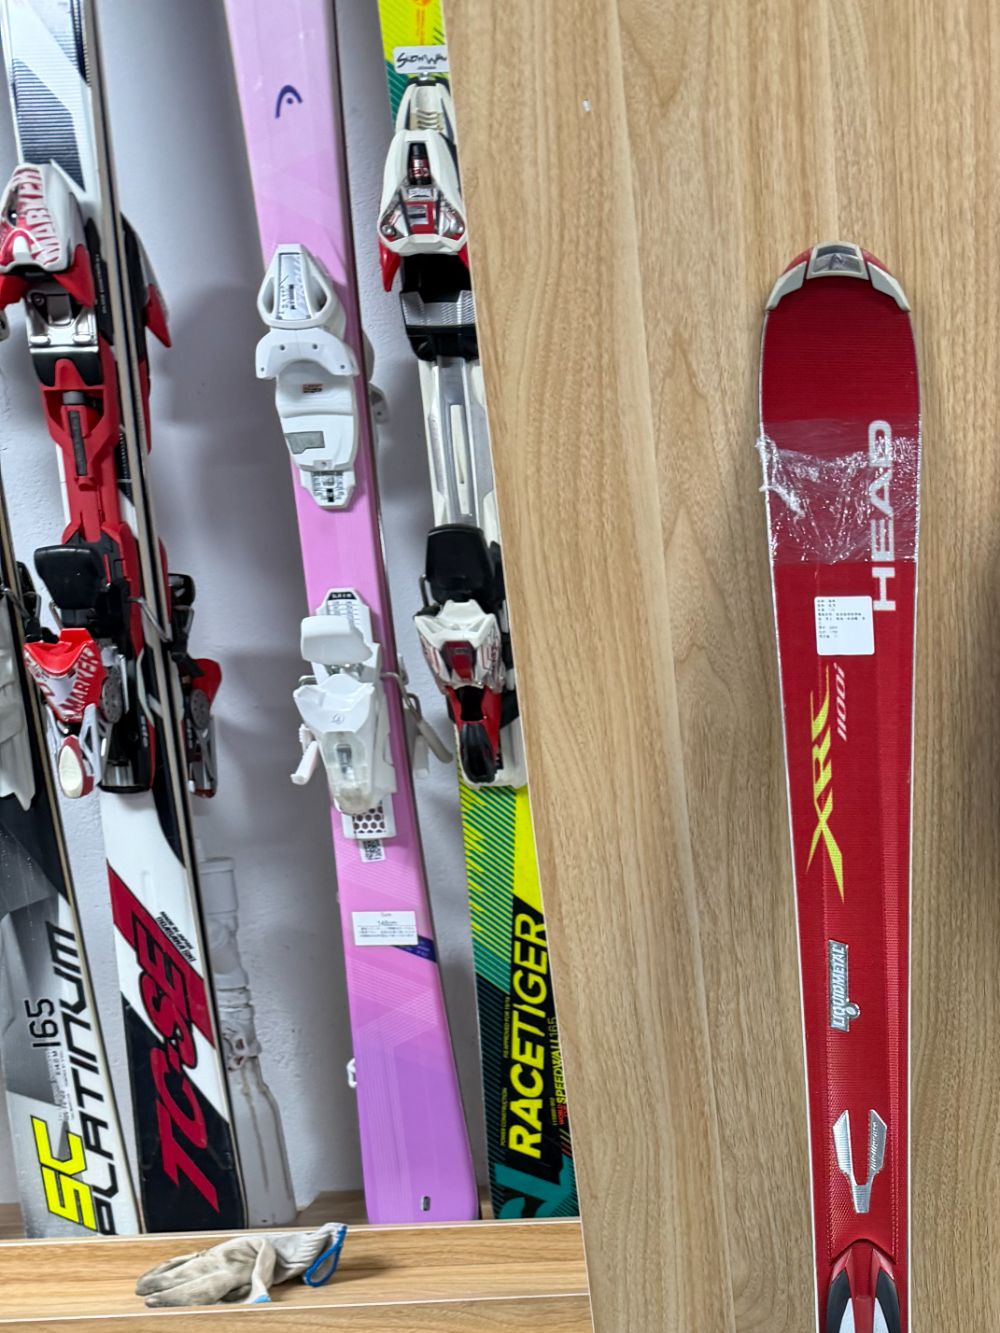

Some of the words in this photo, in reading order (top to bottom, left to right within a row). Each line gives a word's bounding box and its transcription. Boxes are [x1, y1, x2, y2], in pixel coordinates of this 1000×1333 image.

[868, 419, 896, 612] HEAD
[834, 662, 847, 742] 1100i
[805, 665, 845, 903] XRC
[25, 998, 61, 1049] 165
[508, 913, 548, 1159] RACETIGER
[831, 944, 846, 1027] LIQUIDMETAL
[45, 920, 119, 1235] PLATINUM
[30, 1114, 99, 1231] SC
